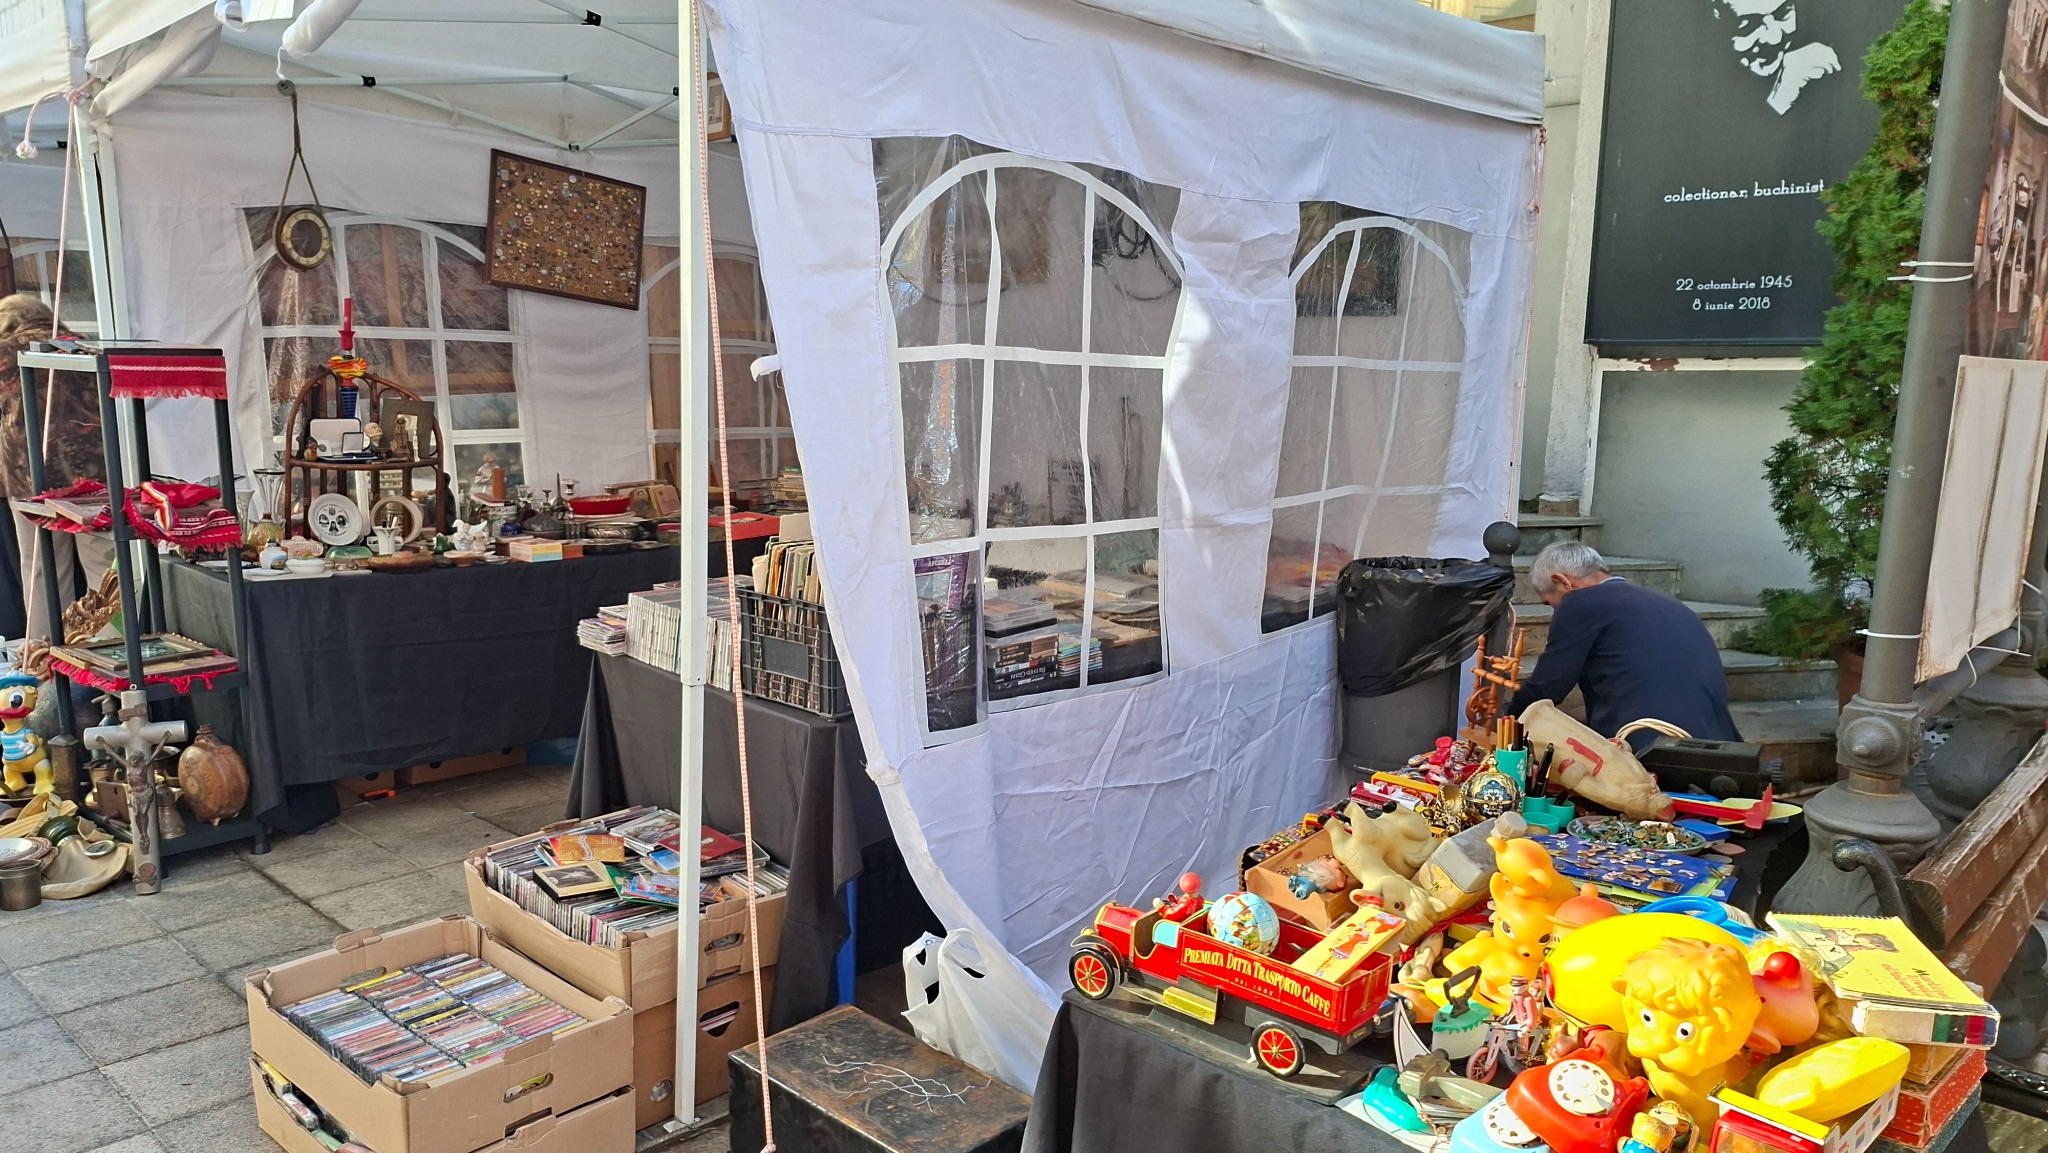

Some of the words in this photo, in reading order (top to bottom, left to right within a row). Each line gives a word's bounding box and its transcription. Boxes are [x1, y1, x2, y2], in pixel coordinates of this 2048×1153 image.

[1753, 179, 1825, 197] buchinist
[1676, 278, 1694, 291] 22
[1697, 277, 1756, 290] octombrie
[1760, 275, 1793, 289] 1945
[1692, 298, 1702, 311] 8
[1705, 301, 1735, 311] iunie
[1738, 296, 1771, 310] 2018
[1183, 947, 1224, 967] PREMIATA
[1226, 953, 1252, 976] DITTA
[1253, 961, 1301, 998] TRASPORTO
